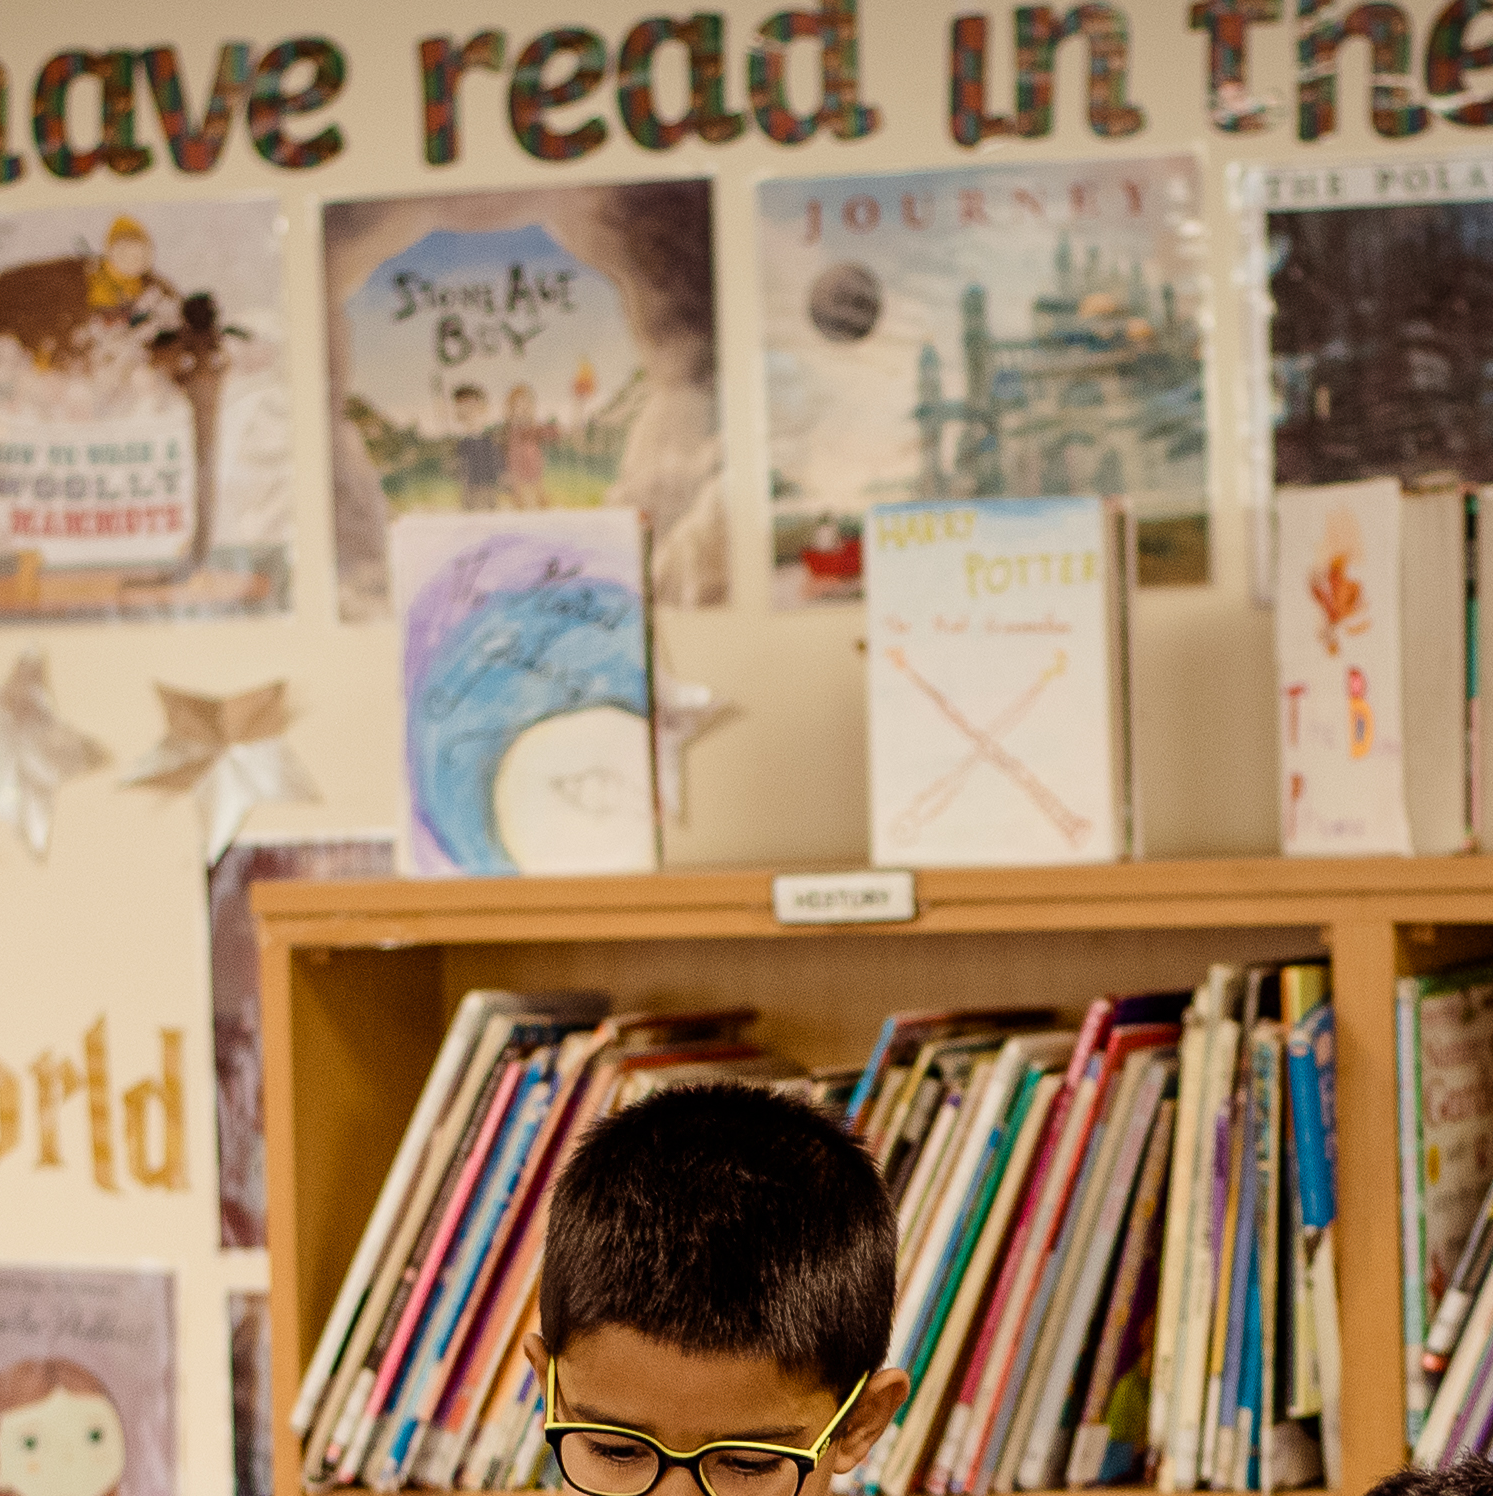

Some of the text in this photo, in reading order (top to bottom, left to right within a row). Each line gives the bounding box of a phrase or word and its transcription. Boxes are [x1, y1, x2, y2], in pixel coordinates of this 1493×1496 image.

[418, 0, 882, 166] read
[947, 0, 1147, 148] in
[799, 179, 1149, 242] JOURNEY
[1264, 169, 1345, 203] THE
[433, 317, 547, 367] BOY
